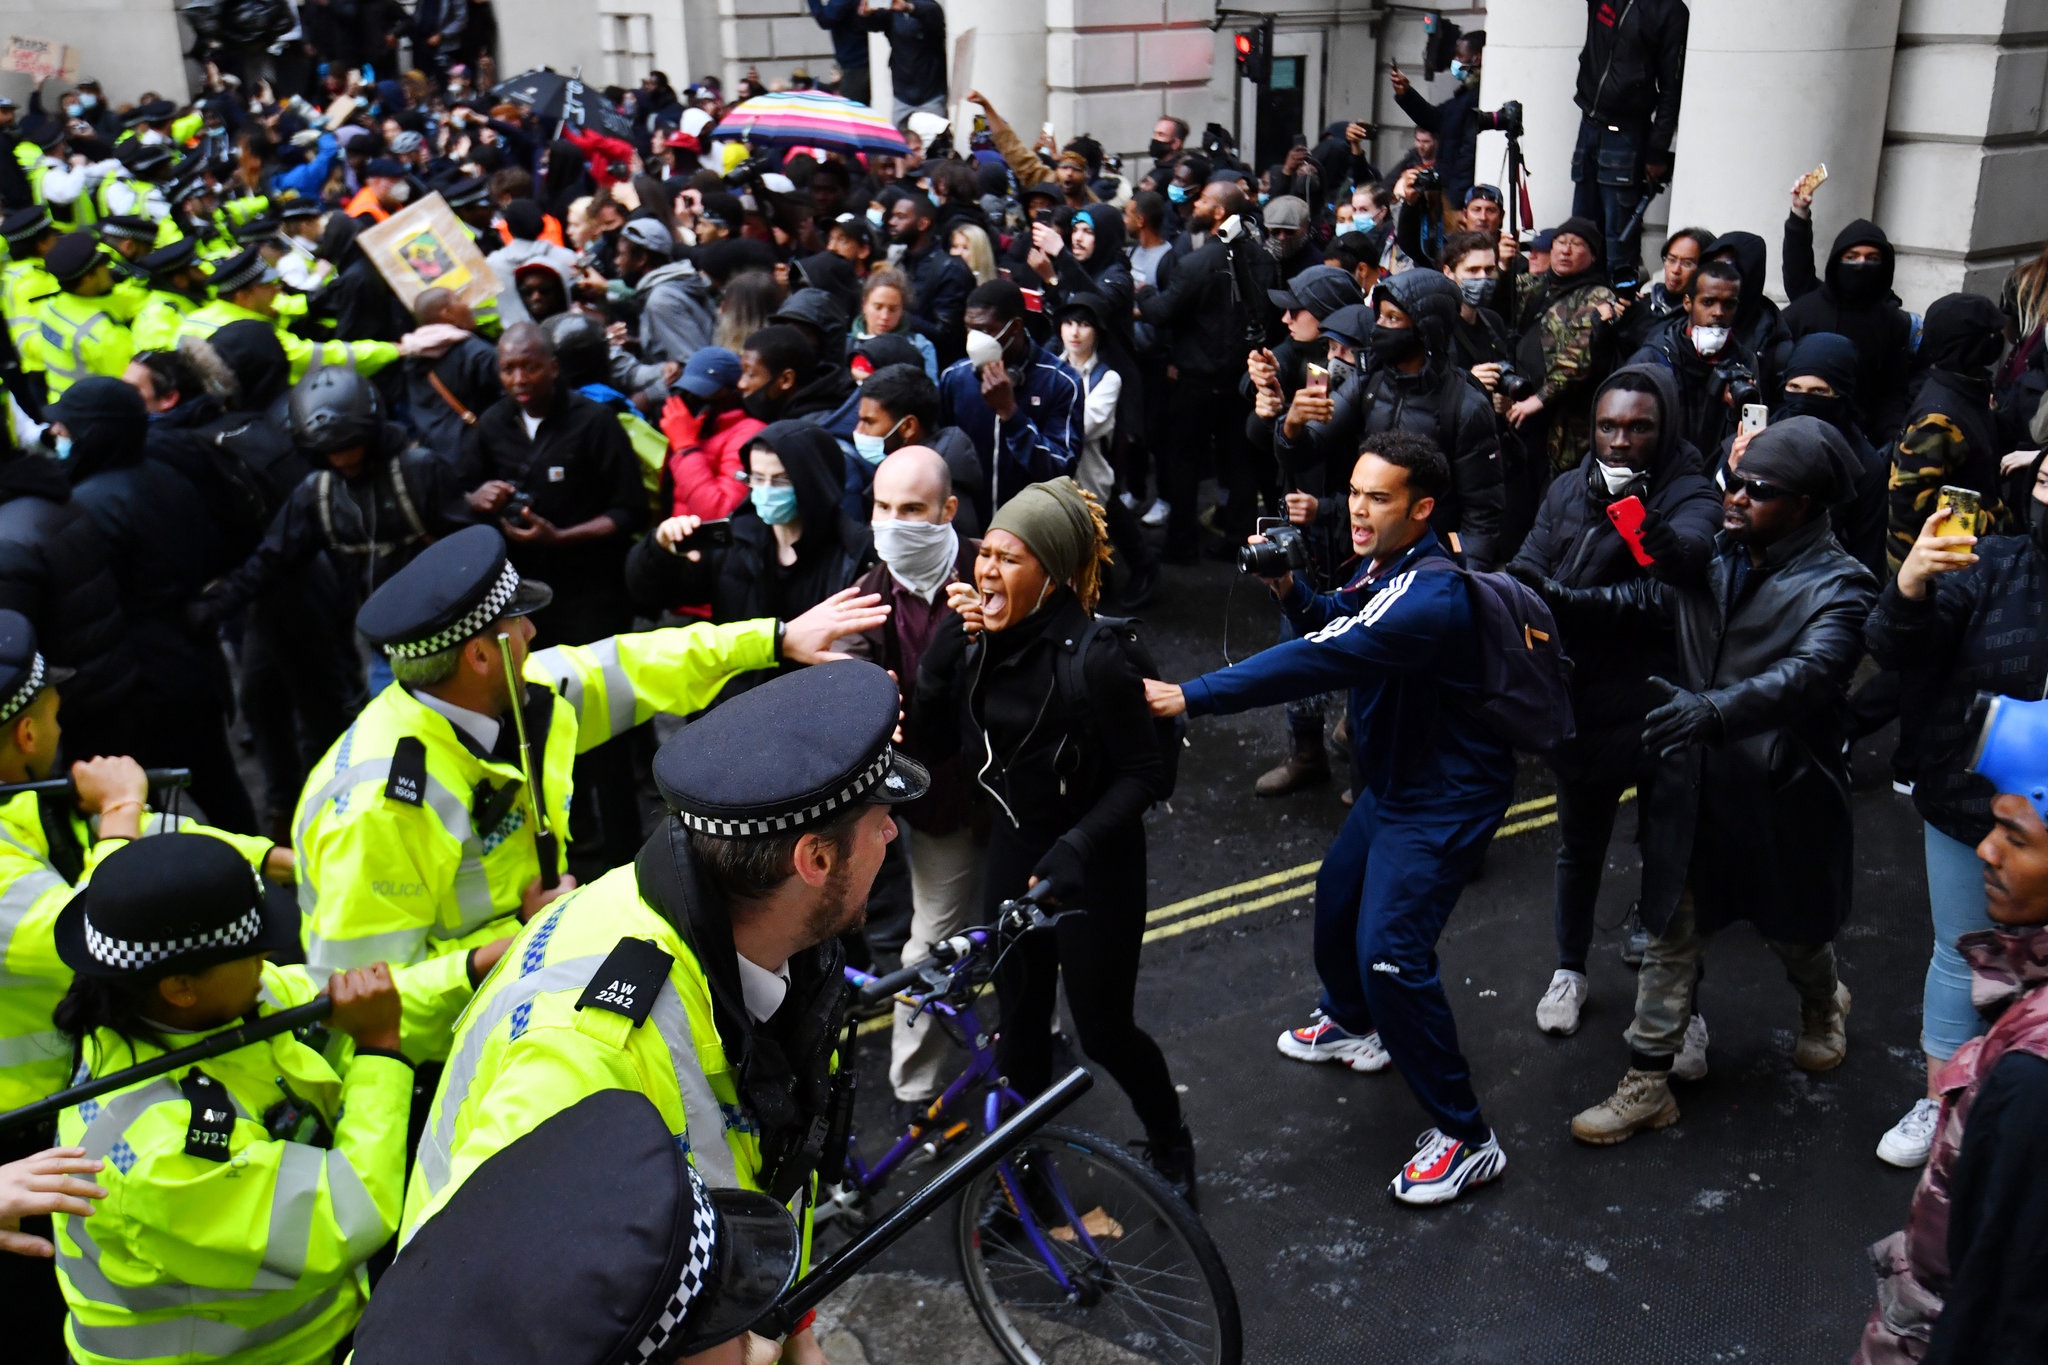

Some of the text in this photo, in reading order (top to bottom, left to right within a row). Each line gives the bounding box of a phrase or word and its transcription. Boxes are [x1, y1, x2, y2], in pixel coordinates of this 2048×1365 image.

[398, 776, 417, 789] WA
[395, 786, 417, 801] 1509
[371, 880, 424, 896] POLICE
[1372, 961, 1400, 974] adidas
[607, 980, 637, 995] AW
[595, 990, 634, 1009] 2242
[203, 1108, 228, 1122] AW
[191, 1128, 228, 1148] 3723
